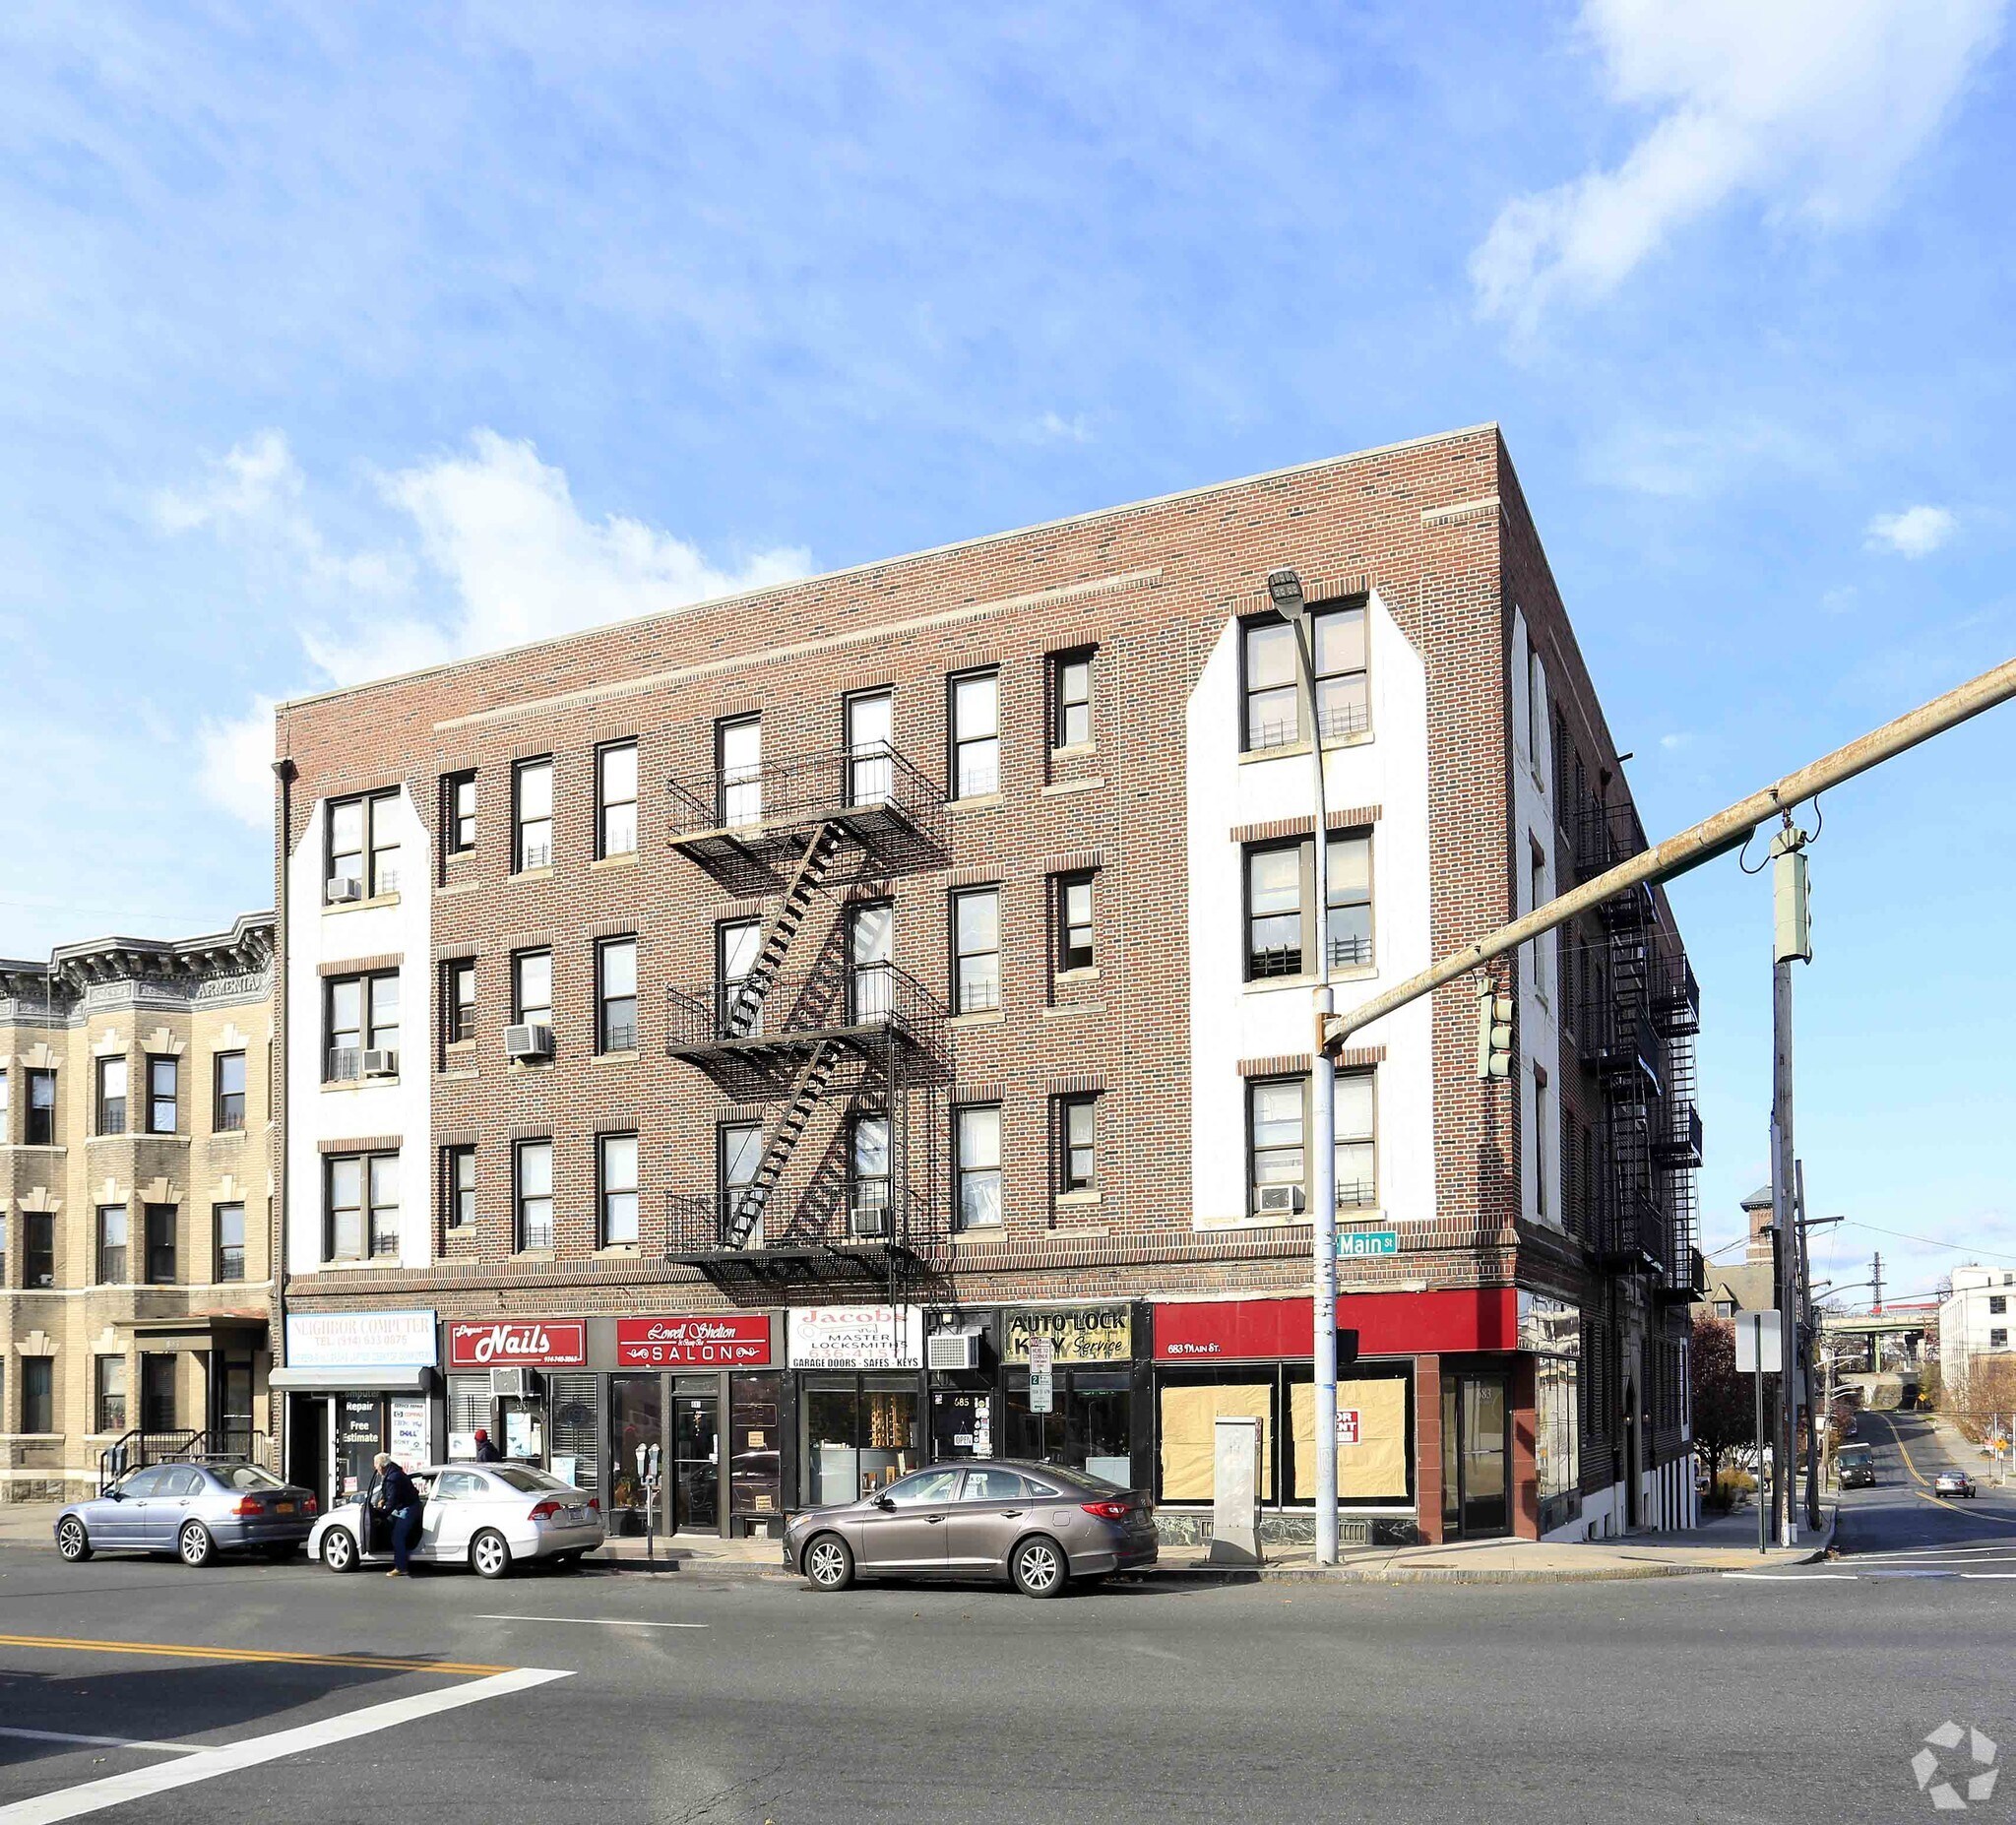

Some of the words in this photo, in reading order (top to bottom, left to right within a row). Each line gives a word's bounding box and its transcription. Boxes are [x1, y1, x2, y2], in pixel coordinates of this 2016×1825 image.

[1340, 1233, 1382, 1254] Main
[1384, 1237, 1393, 1248] St
[802, 1308, 909, 1323] Jacobs
[360, 1317, 429, 1334] COMPUTER
[1010, 1313, 1066, 1333] AUTO
[1073, 1311, 1126, 1331] LOCK
[648, 1322, 687, 1340] Lowell
[688, 1322, 736, 1340] Shelton
[474, 1324, 550, 1363] Nails
[811, 1340, 908, 1349] LOCKSMITHS
[1015, 1337, 1066, 1355] KY
[1073, 1336, 1123, 1355] Service
[1167, 1344, 1183, 1354] 683
[652, 1346, 732, 1360] SALON
[792, 1358, 825, 1367] GARAGE
[827, 1358, 856, 1367] DOORS
[863, 1357, 890, 1367] SAFES
[897, 1357, 918, 1366] KEYS
[346, 1401, 374, 1413] Repair
[954, 1397, 970, 1407] 685
[1336, 1412, 1353, 1422] OR
[349, 1420, 370, 1430] Free
[1337, 1421, 1357, 1431] NT
[344, 1432, 379, 1443] Estimate
[955, 1435, 972, 1445] OPEN
